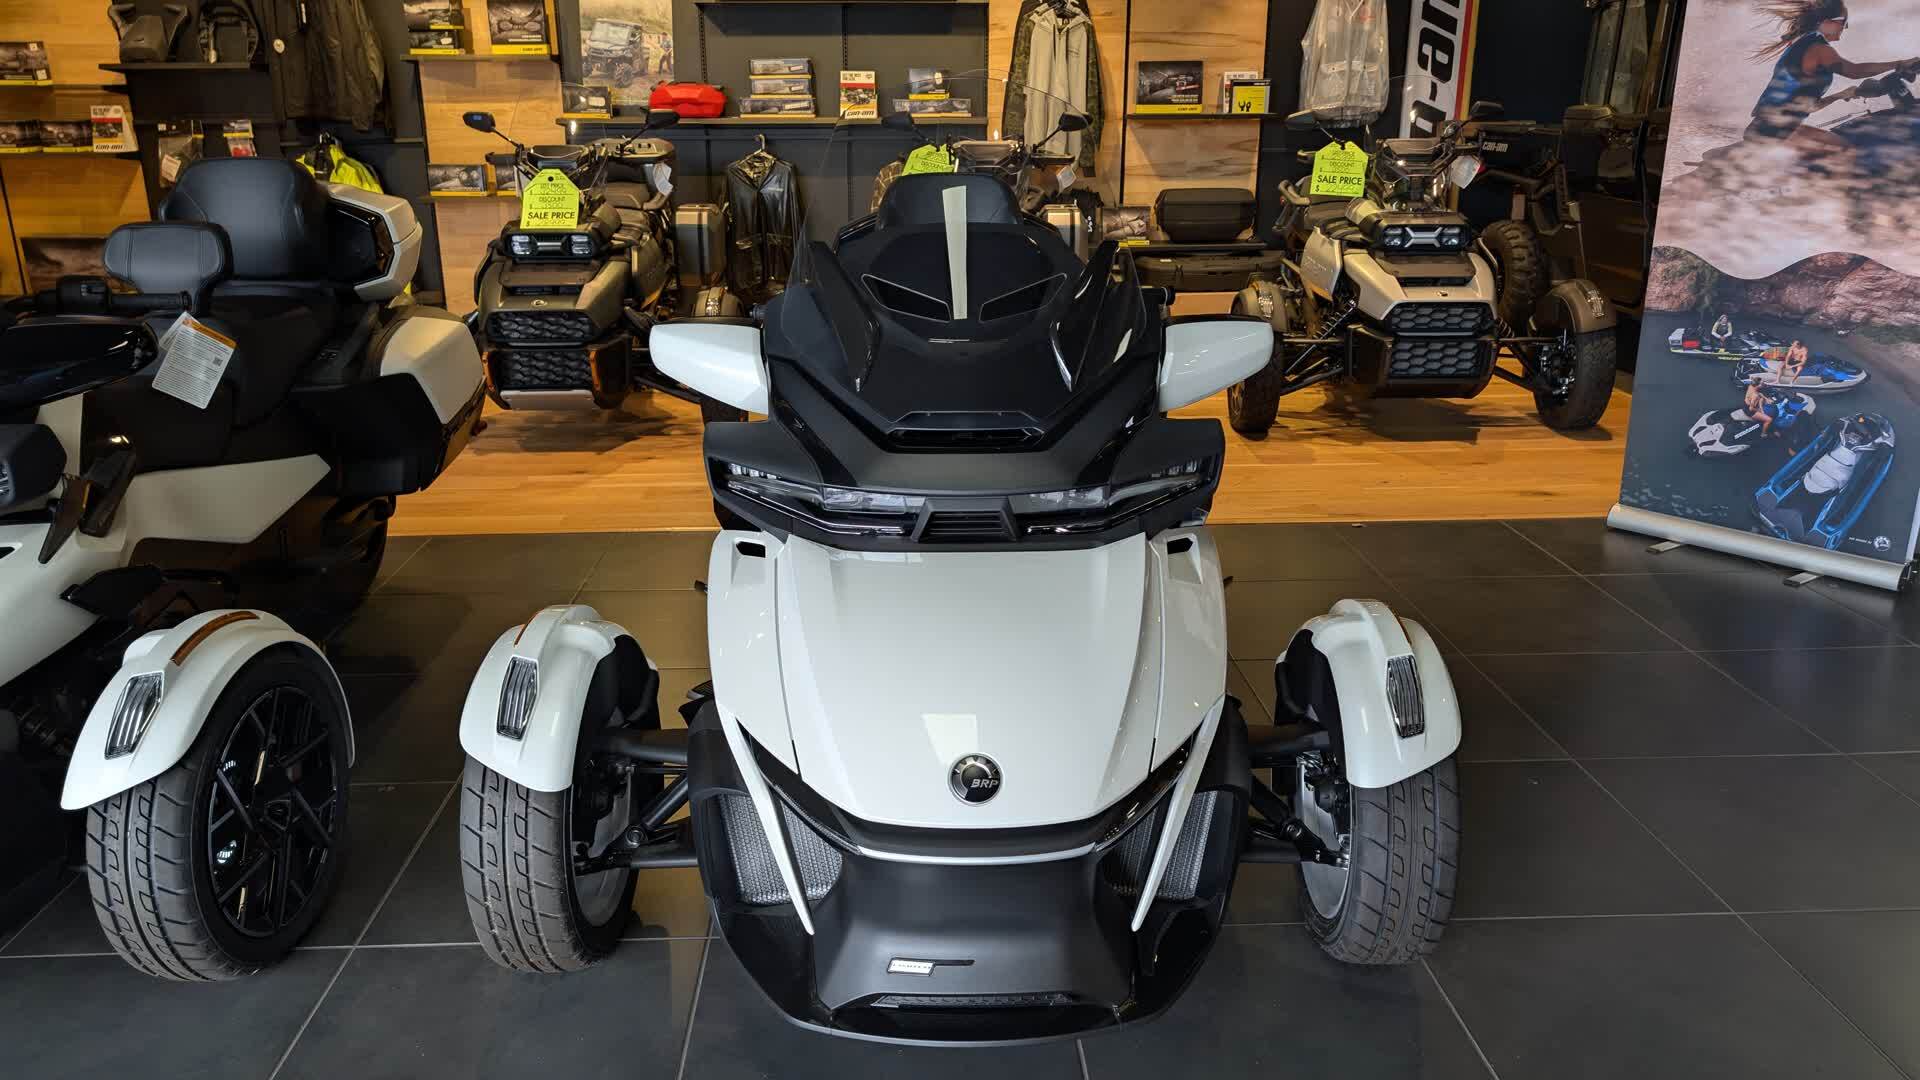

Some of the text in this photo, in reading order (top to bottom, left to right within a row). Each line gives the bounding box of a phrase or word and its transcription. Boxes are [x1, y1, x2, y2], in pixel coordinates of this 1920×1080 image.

[1317, 174, 1362, 185] SALE PRICE
[528, 211, 575, 219] SALE PRICE
[970, 778, 998, 788] BRP
